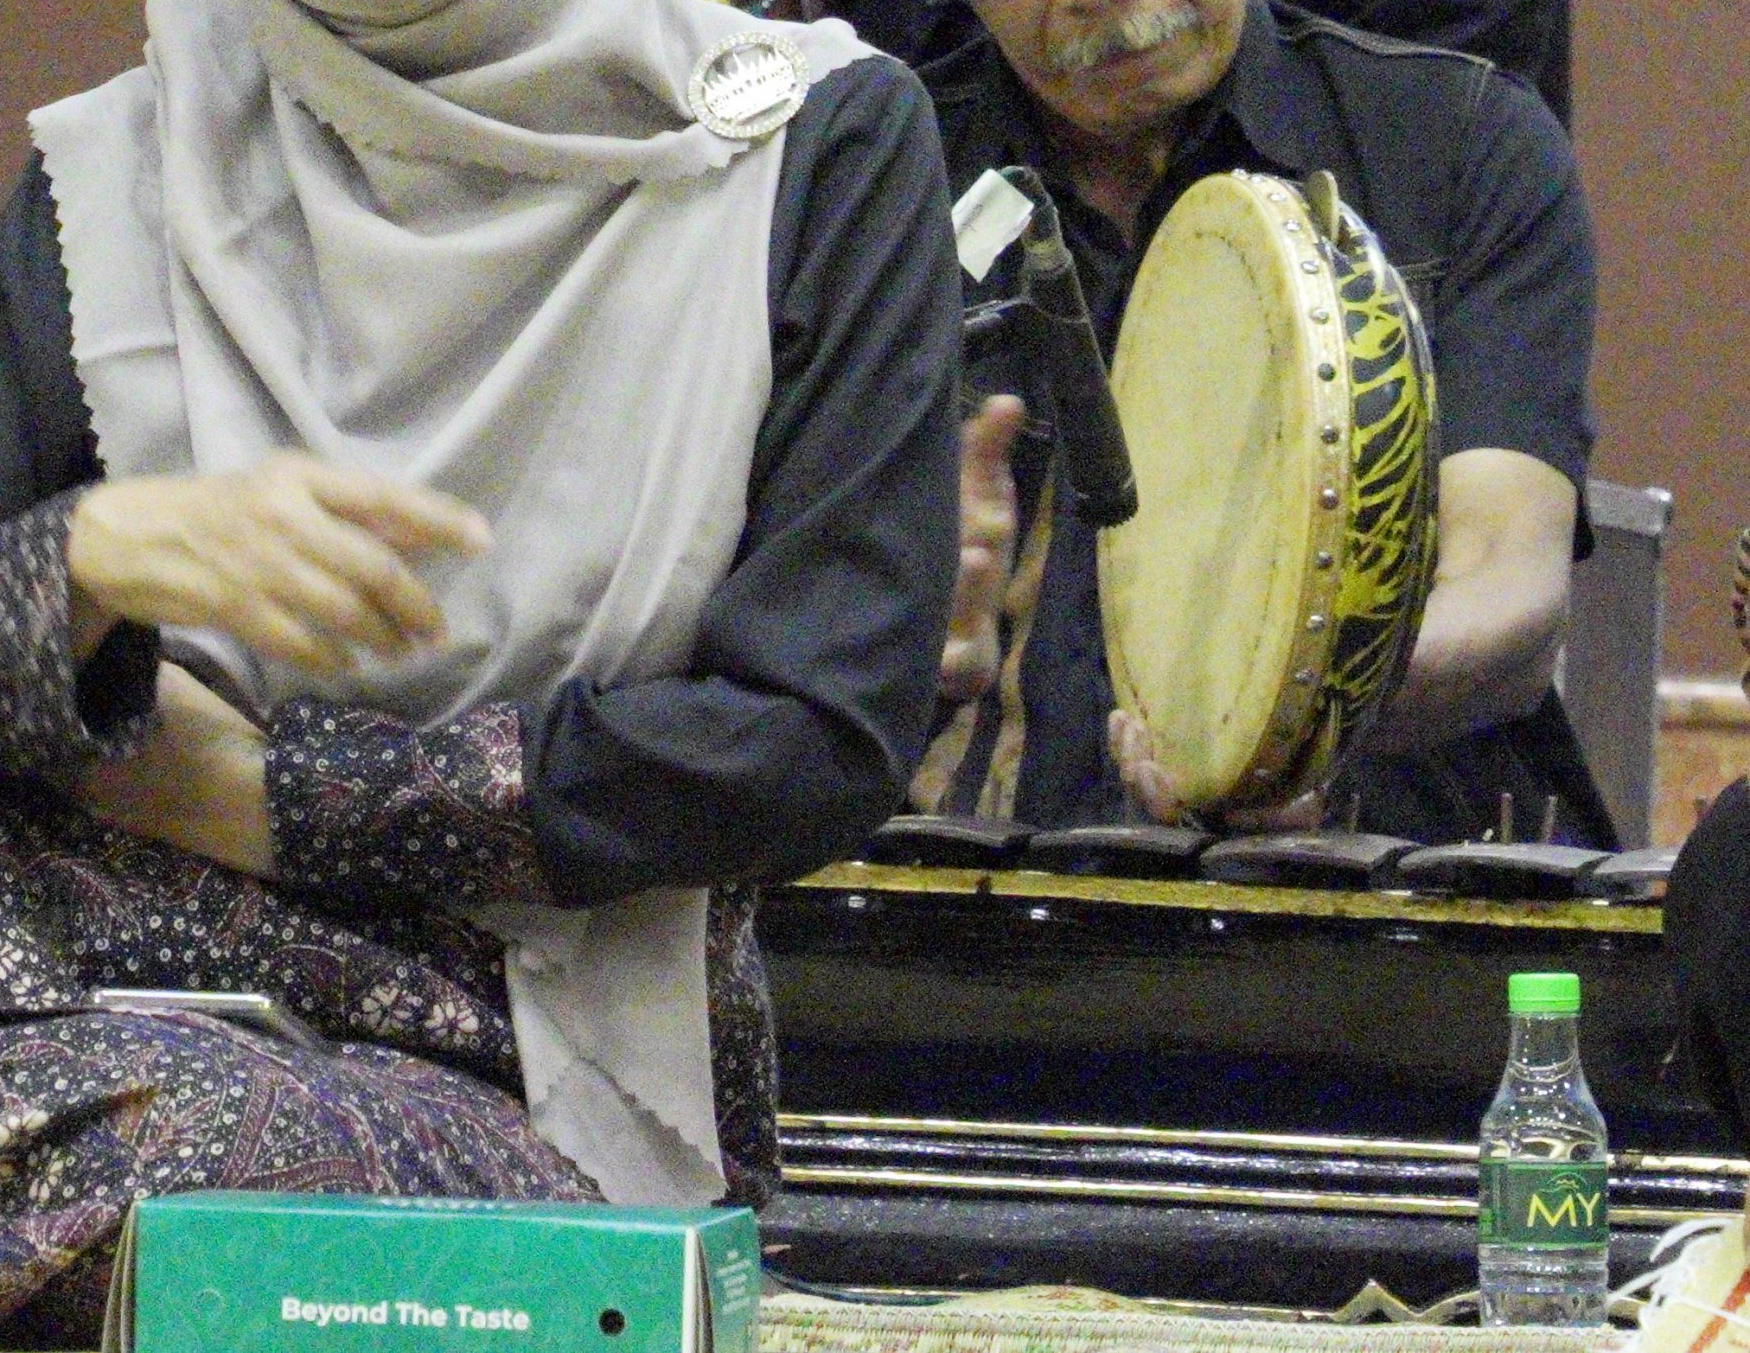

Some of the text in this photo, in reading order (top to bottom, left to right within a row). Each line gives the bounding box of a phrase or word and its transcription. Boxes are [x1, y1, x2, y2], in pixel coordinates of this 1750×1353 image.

[1527, 1192, 1601, 1227] MY
[280, 1297, 530, 1331] Beyond The Taste
